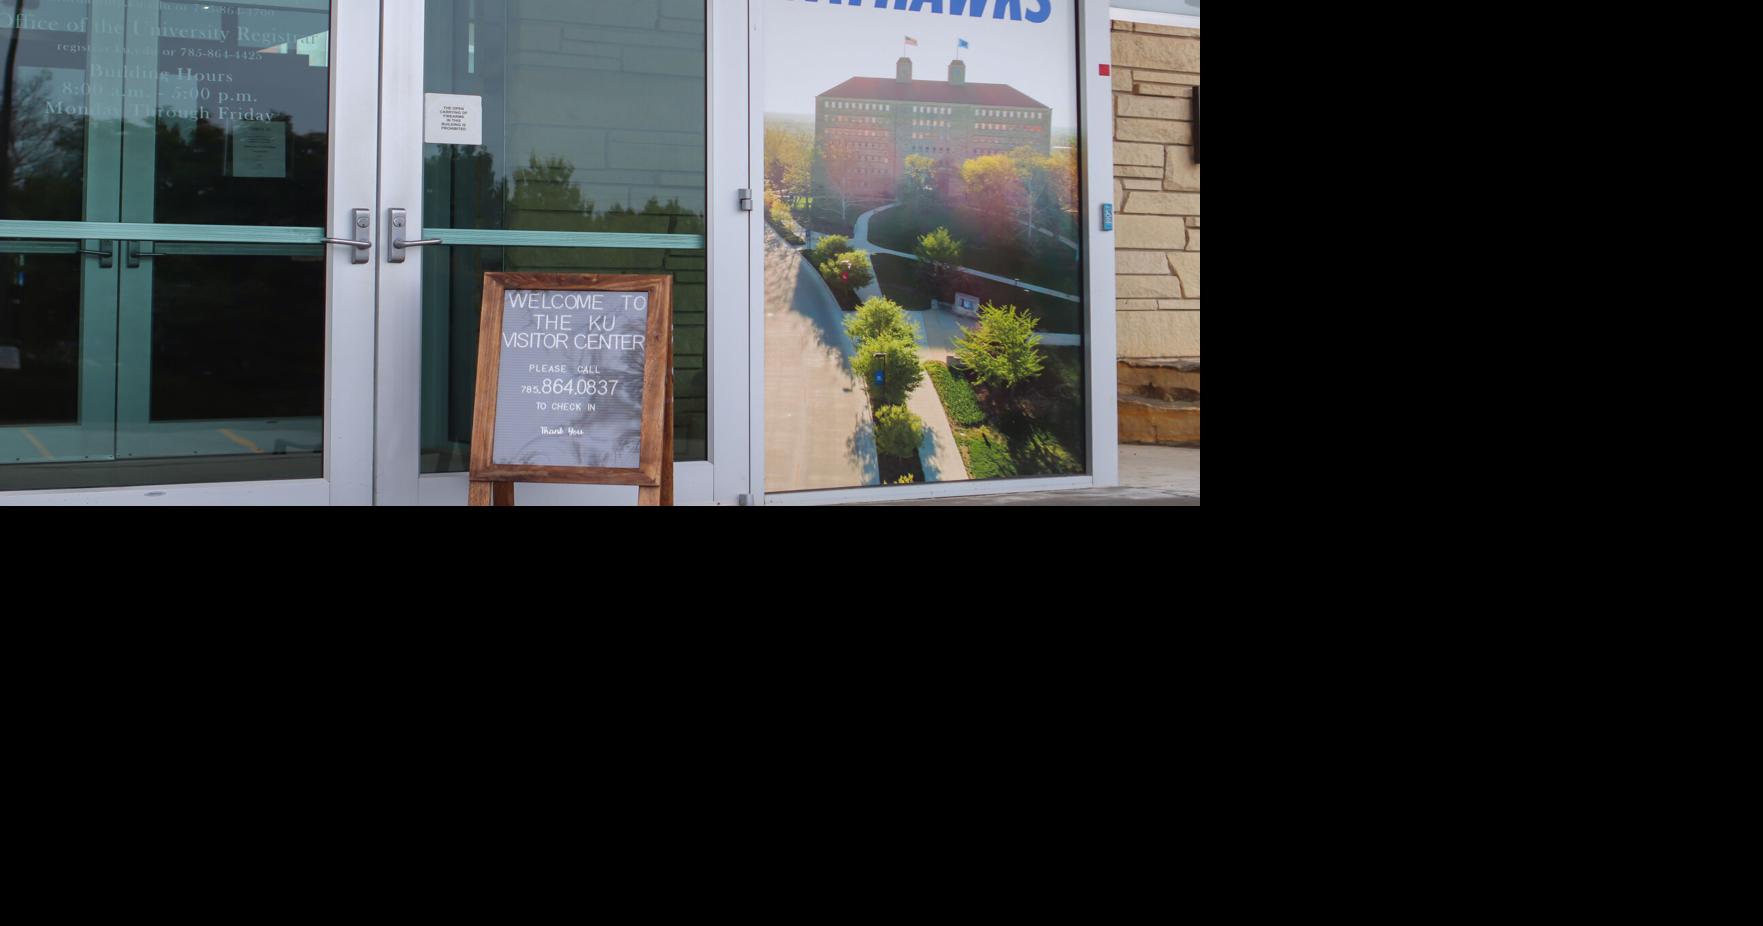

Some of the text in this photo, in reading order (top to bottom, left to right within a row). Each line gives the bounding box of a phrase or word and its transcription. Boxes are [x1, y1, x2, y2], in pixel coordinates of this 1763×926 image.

[66, 16, 89, 33] of
[94, 17, 122, 33] the
[131, 19, 227, 43] University
[162, 48, 177, 57] or
[90, 63, 233, 82] Building Hours
[62, 82, 104, 97] 8:00
[171, 85, 210, 100] 5:00
[218, 91, 257, 104] p.m.
[46, 101, 276, 124] Monday Through Friday
[508, 292, 647, 311] WELCOME TO
[533, 314, 617, 332] THE KU
[502, 332, 646, 351] VISITOR CENTER
[528, 364, 601, 374] PLEASE CALL
[521, 378, 619, 396] 785.864.0837
[536, 402, 596, 412] TO CHECK IN
[541, 426, 585, 437] Thank You
